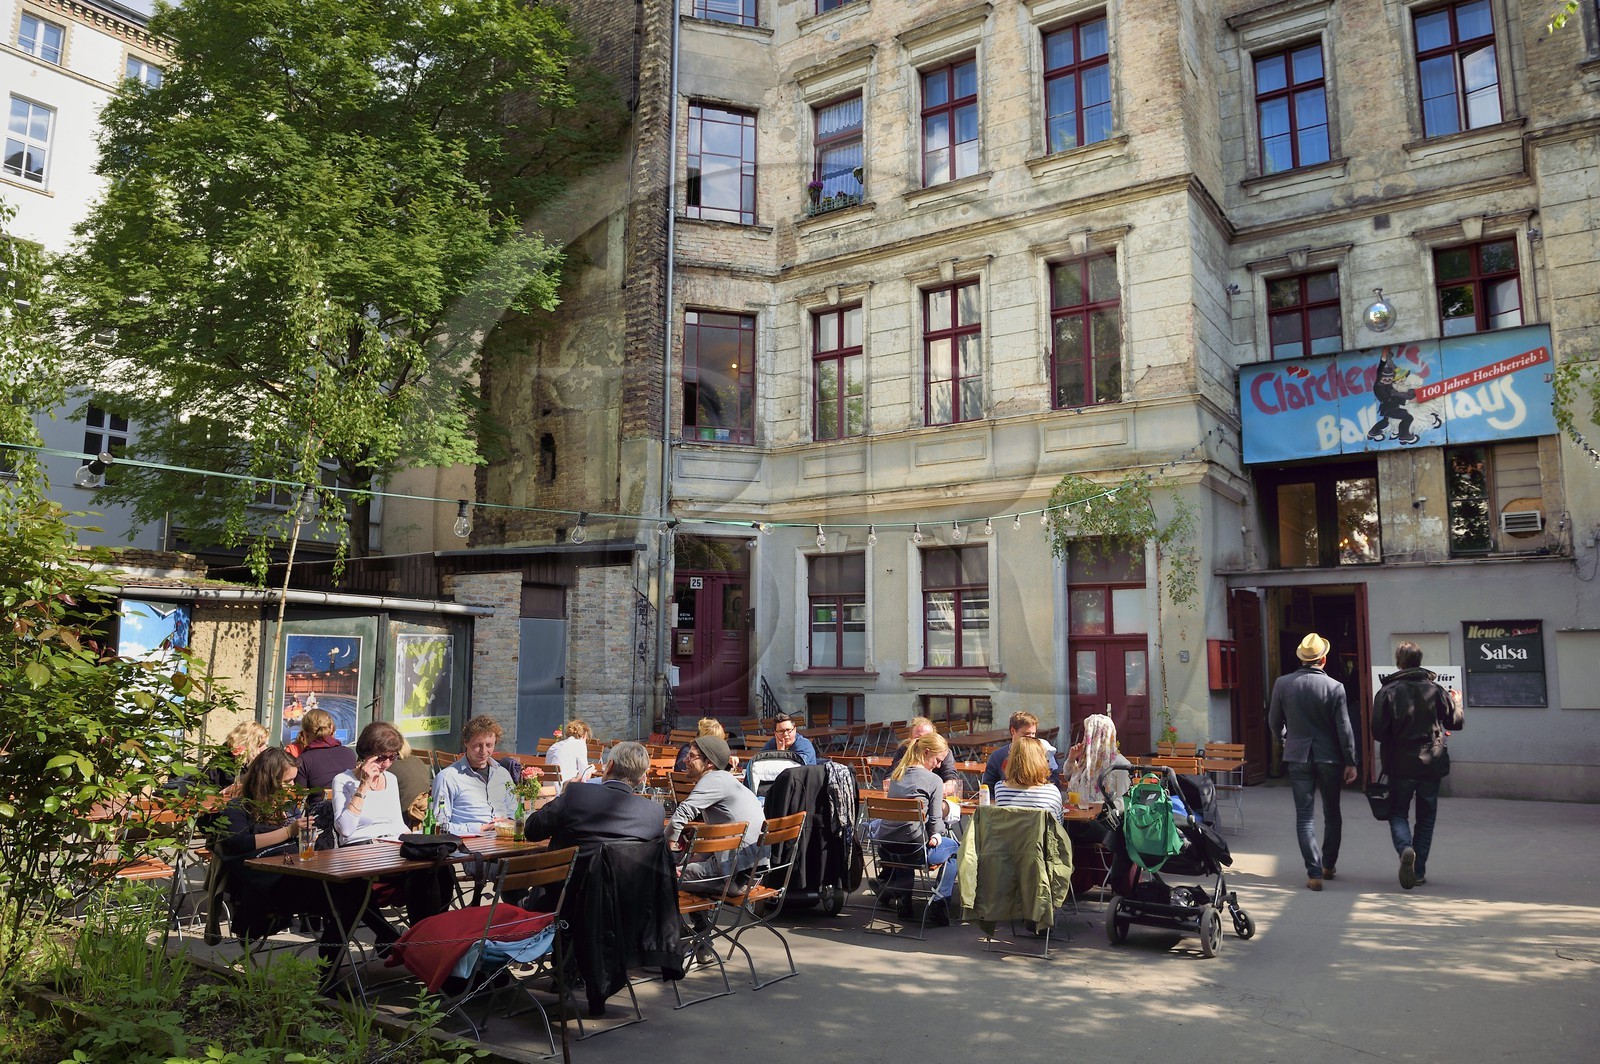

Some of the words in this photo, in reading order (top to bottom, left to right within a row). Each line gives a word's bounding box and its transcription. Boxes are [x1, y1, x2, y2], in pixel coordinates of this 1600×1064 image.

[1422, 385, 1441, 398] 100
[1442, 378, 1470, 394] Jahre
[1473, 352, 1537, 382] Hochbetrieb
[692, 579, 701, 588] 25
[1468, 625, 1505, 639] Heute
[1480, 643, 1528, 660] Salsa
[1437, 673, 1455, 682] für
